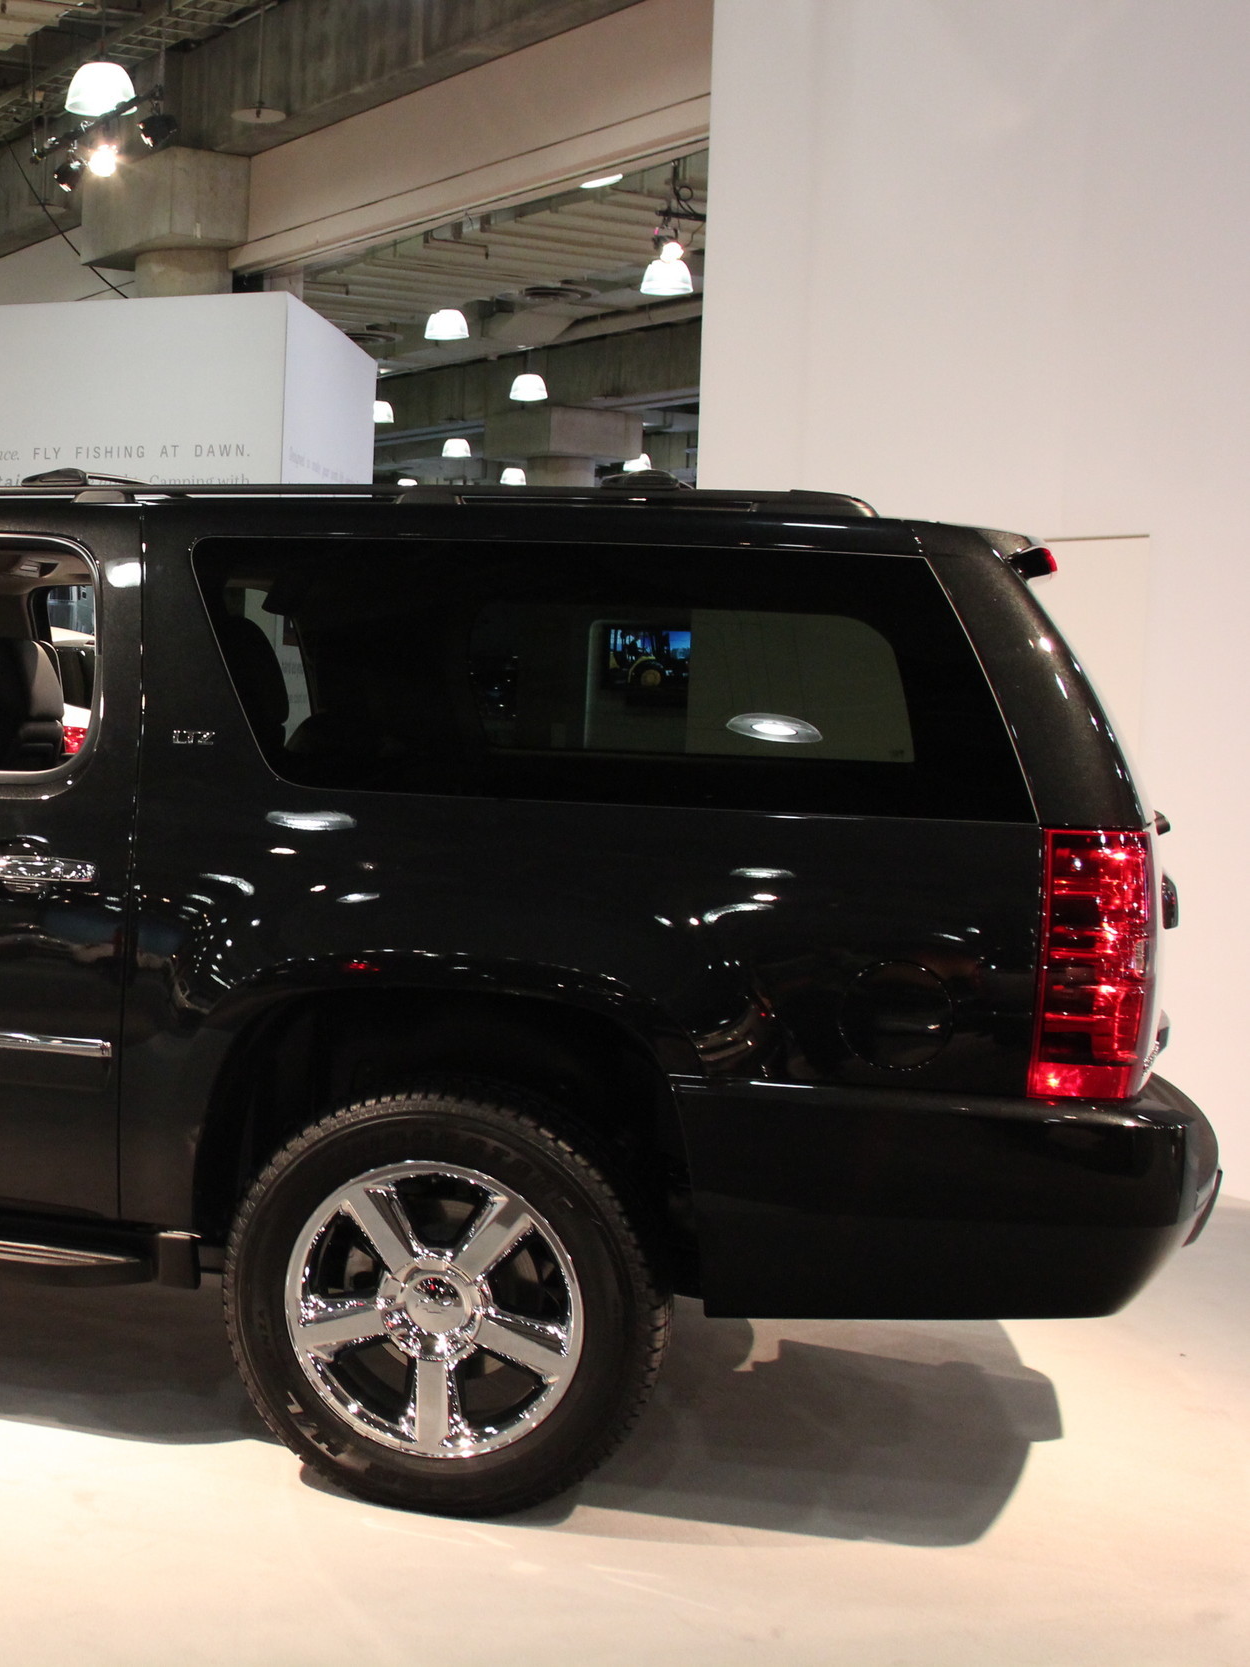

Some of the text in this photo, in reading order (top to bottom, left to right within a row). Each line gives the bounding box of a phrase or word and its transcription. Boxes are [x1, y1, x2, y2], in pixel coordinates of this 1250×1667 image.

[33, 447, 61, 460] FLY
[75, 445, 145, 459] FISHING
[160, 445, 179, 458] AT
[194, 444, 250, 457] DAWN.
[173, 730, 215, 745] LTZ
